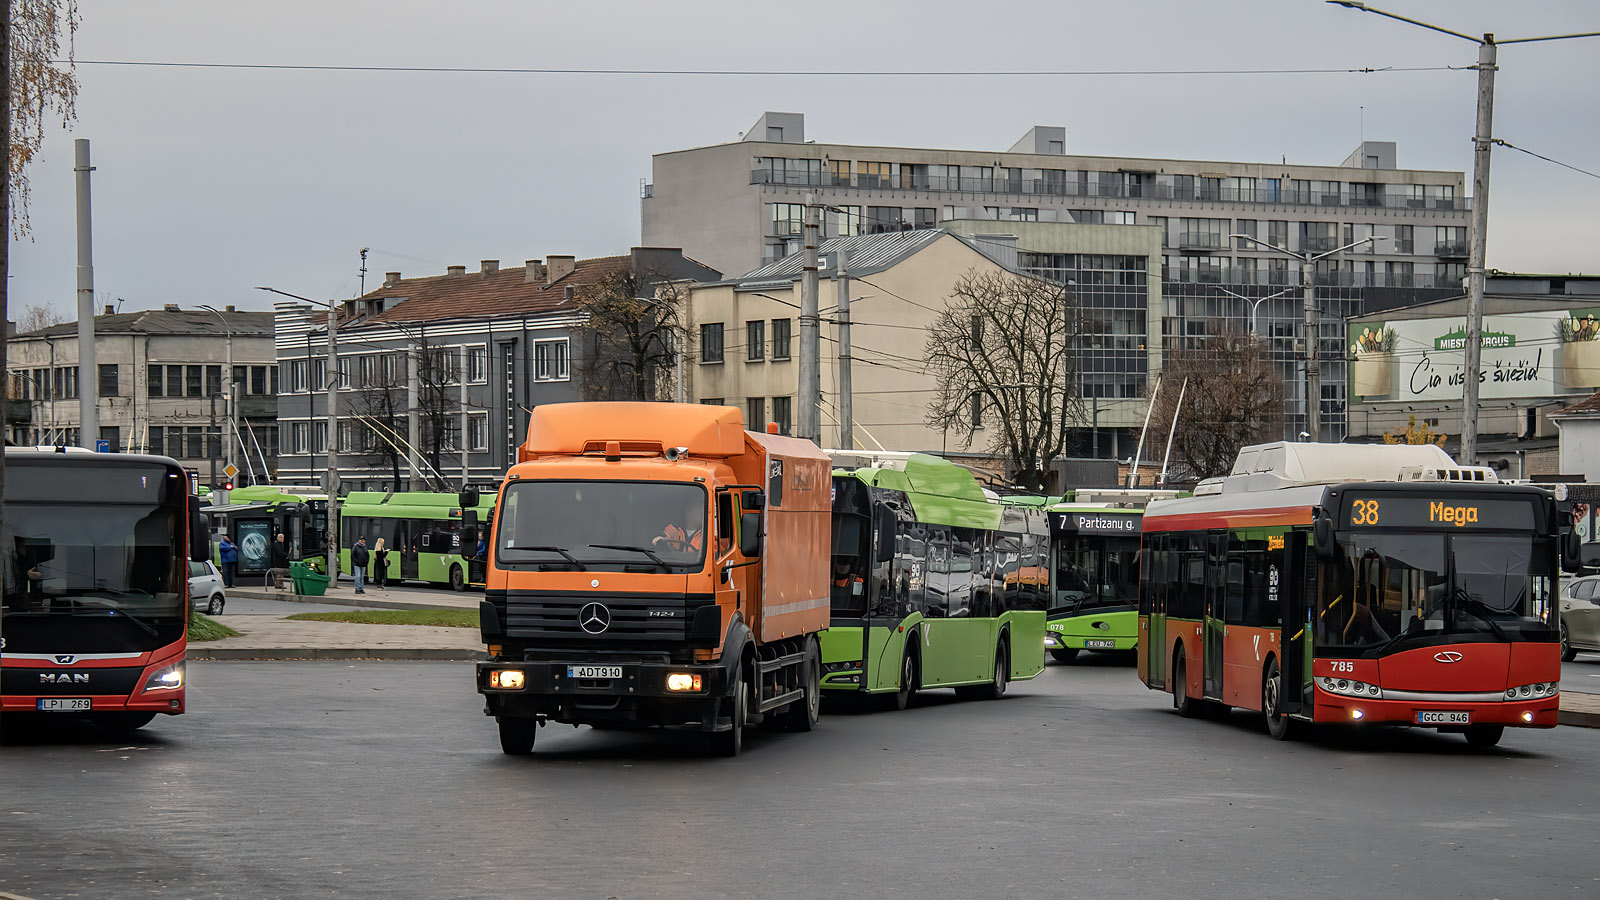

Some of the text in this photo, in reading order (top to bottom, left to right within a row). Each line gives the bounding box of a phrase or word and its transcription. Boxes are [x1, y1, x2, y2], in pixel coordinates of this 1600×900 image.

[1440, 336, 1509, 349] MIEST URGUS
[1410, 350, 1442, 395] Čia
[1448, 365, 1487, 387] viss
[1352, 499, 1478, 527] 38 Mega
[1059, 514, 1135, 531] 7 Partizanų g.
[1330, 661, 1354, 672] 785
[39, 673, 90, 683] MAN
[43, 700, 90, 709] LPI 269
[1423, 713, 1468, 722] GCC 946
